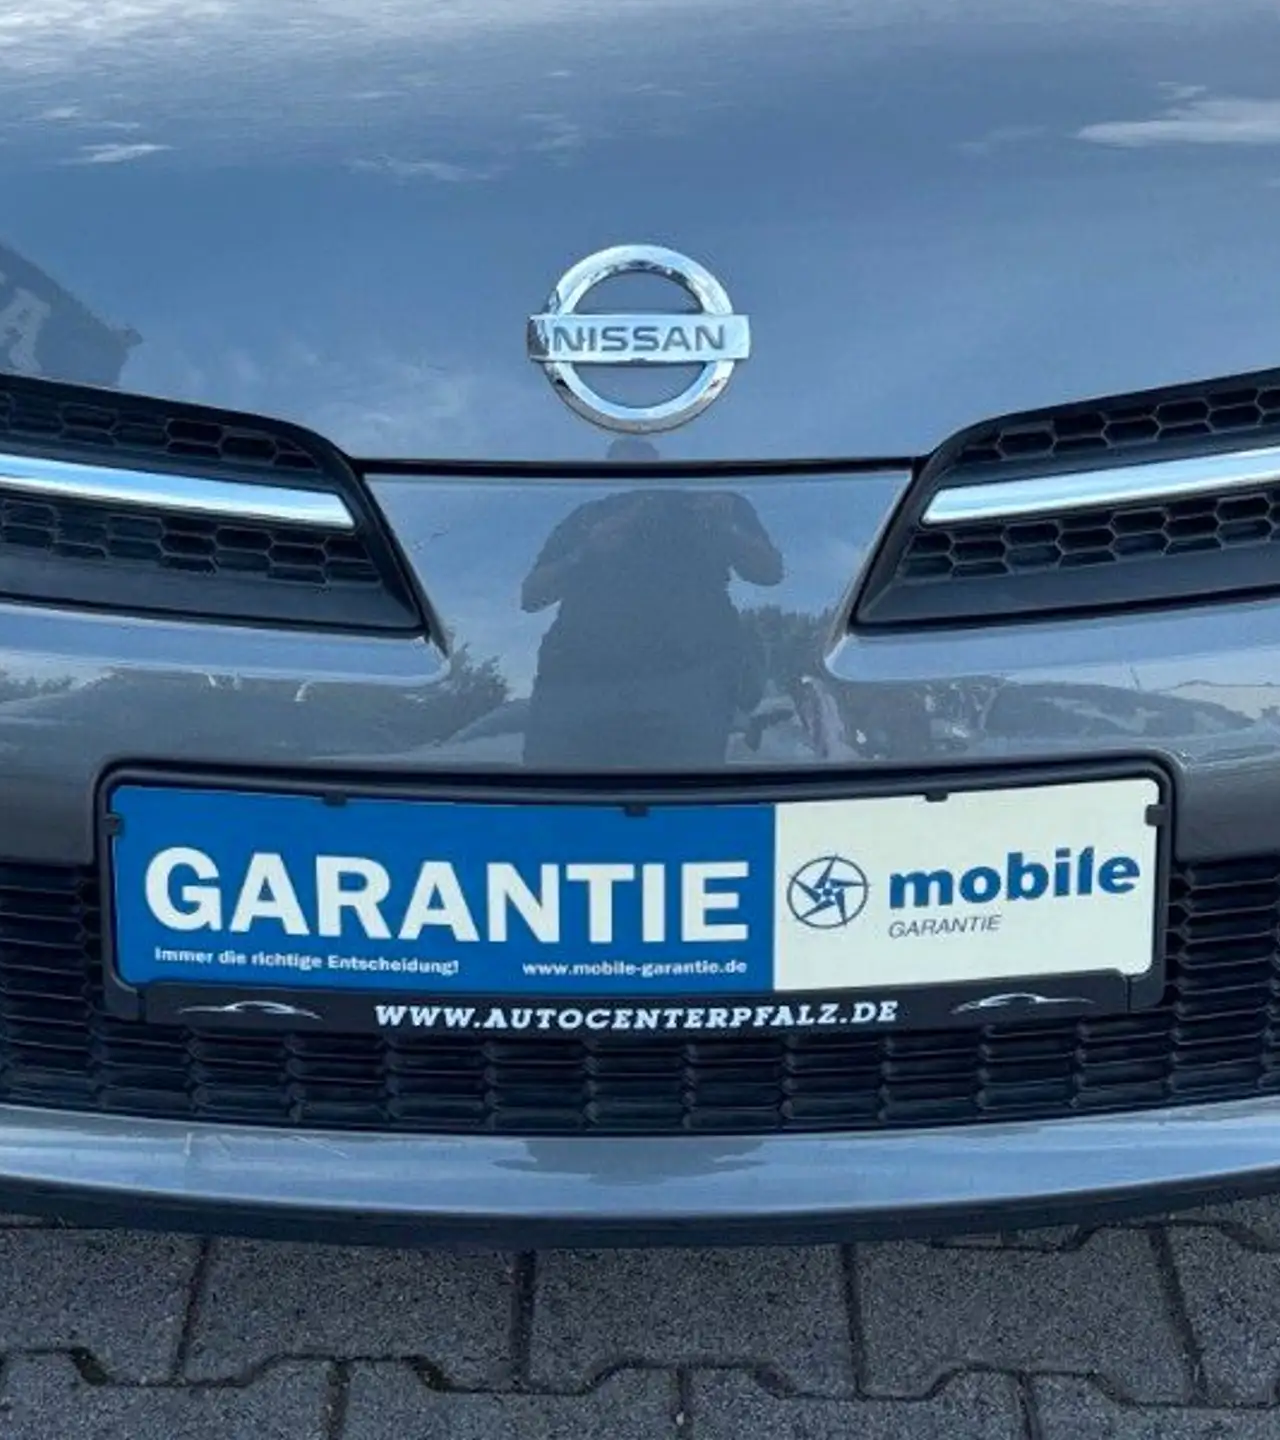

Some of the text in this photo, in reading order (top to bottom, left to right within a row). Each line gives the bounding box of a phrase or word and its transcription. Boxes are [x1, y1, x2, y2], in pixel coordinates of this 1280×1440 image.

[552, 325, 726, 352] NISSAN
[889, 845, 1141, 910] mobile
[144, 845, 750, 944] GARANTIE
[888, 914, 1002, 940] GARANTIE
[153, 946, 460, 976] Immer die richtige Entscheidung!
[521, 959, 748, 978] www.mobile-garantie.de
[374, 1000, 898, 1030] WWW.AUTOCENTERPFALZ.DE
